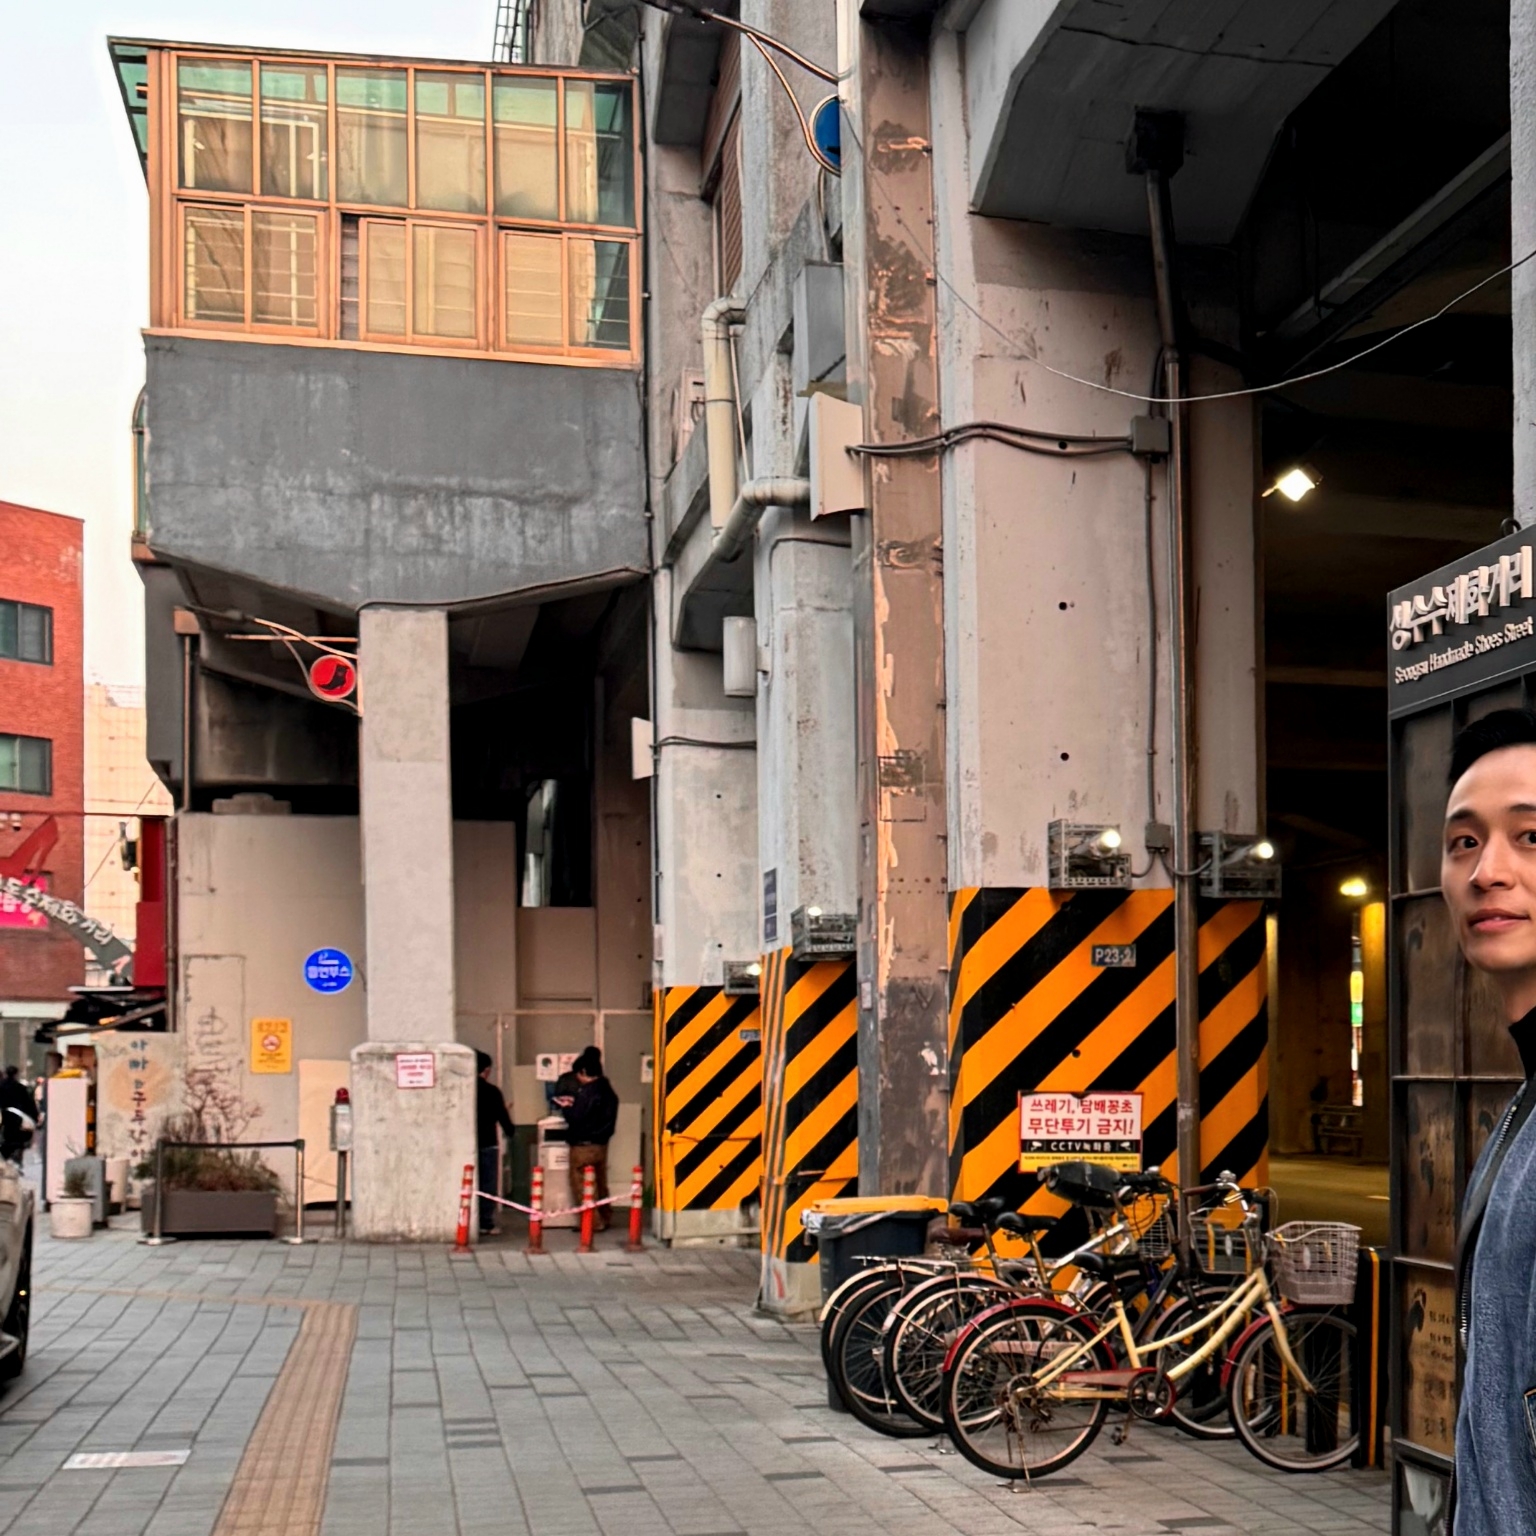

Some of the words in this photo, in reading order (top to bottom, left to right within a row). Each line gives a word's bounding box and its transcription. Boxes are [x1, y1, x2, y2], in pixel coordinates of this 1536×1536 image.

[1395, 660, 1429, 684] Seongsu
[1430, 640, 1474, 672] Handmade
[1475, 631, 1504, 655] Shoes
[1504, 615, 1534, 643] Street
[1030, 1099, 1076, 1115] 쓰레기,
[1079, 1098, 1134, 1115] 담배꽁초
[1028, 1118, 1091, 1135] 무단투기
[1096, 1118, 1134, 1136] 금지!
